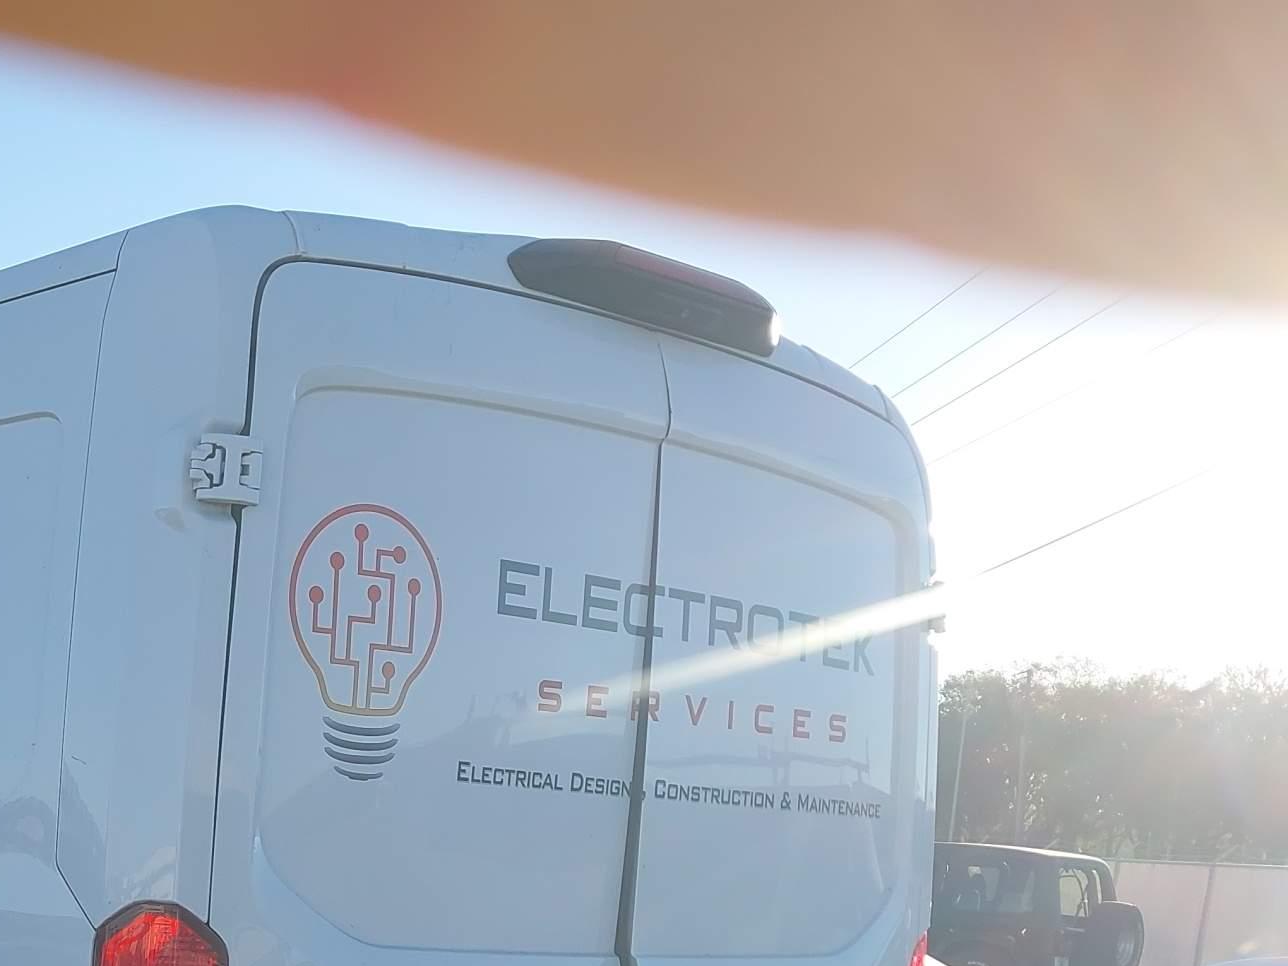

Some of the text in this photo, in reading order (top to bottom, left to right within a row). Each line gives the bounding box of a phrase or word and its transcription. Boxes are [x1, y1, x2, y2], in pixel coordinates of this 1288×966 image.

[497, 559, 875, 677] ELECTROTEK
[537, 679, 848, 743] SERVICES
[456, 760, 563, 792] ELECTRICAL
[654, 779, 775, 810] CONSTRUCTION
[781, 792, 792, 811] &
[797, 793, 881, 819] MAINTENANCE
